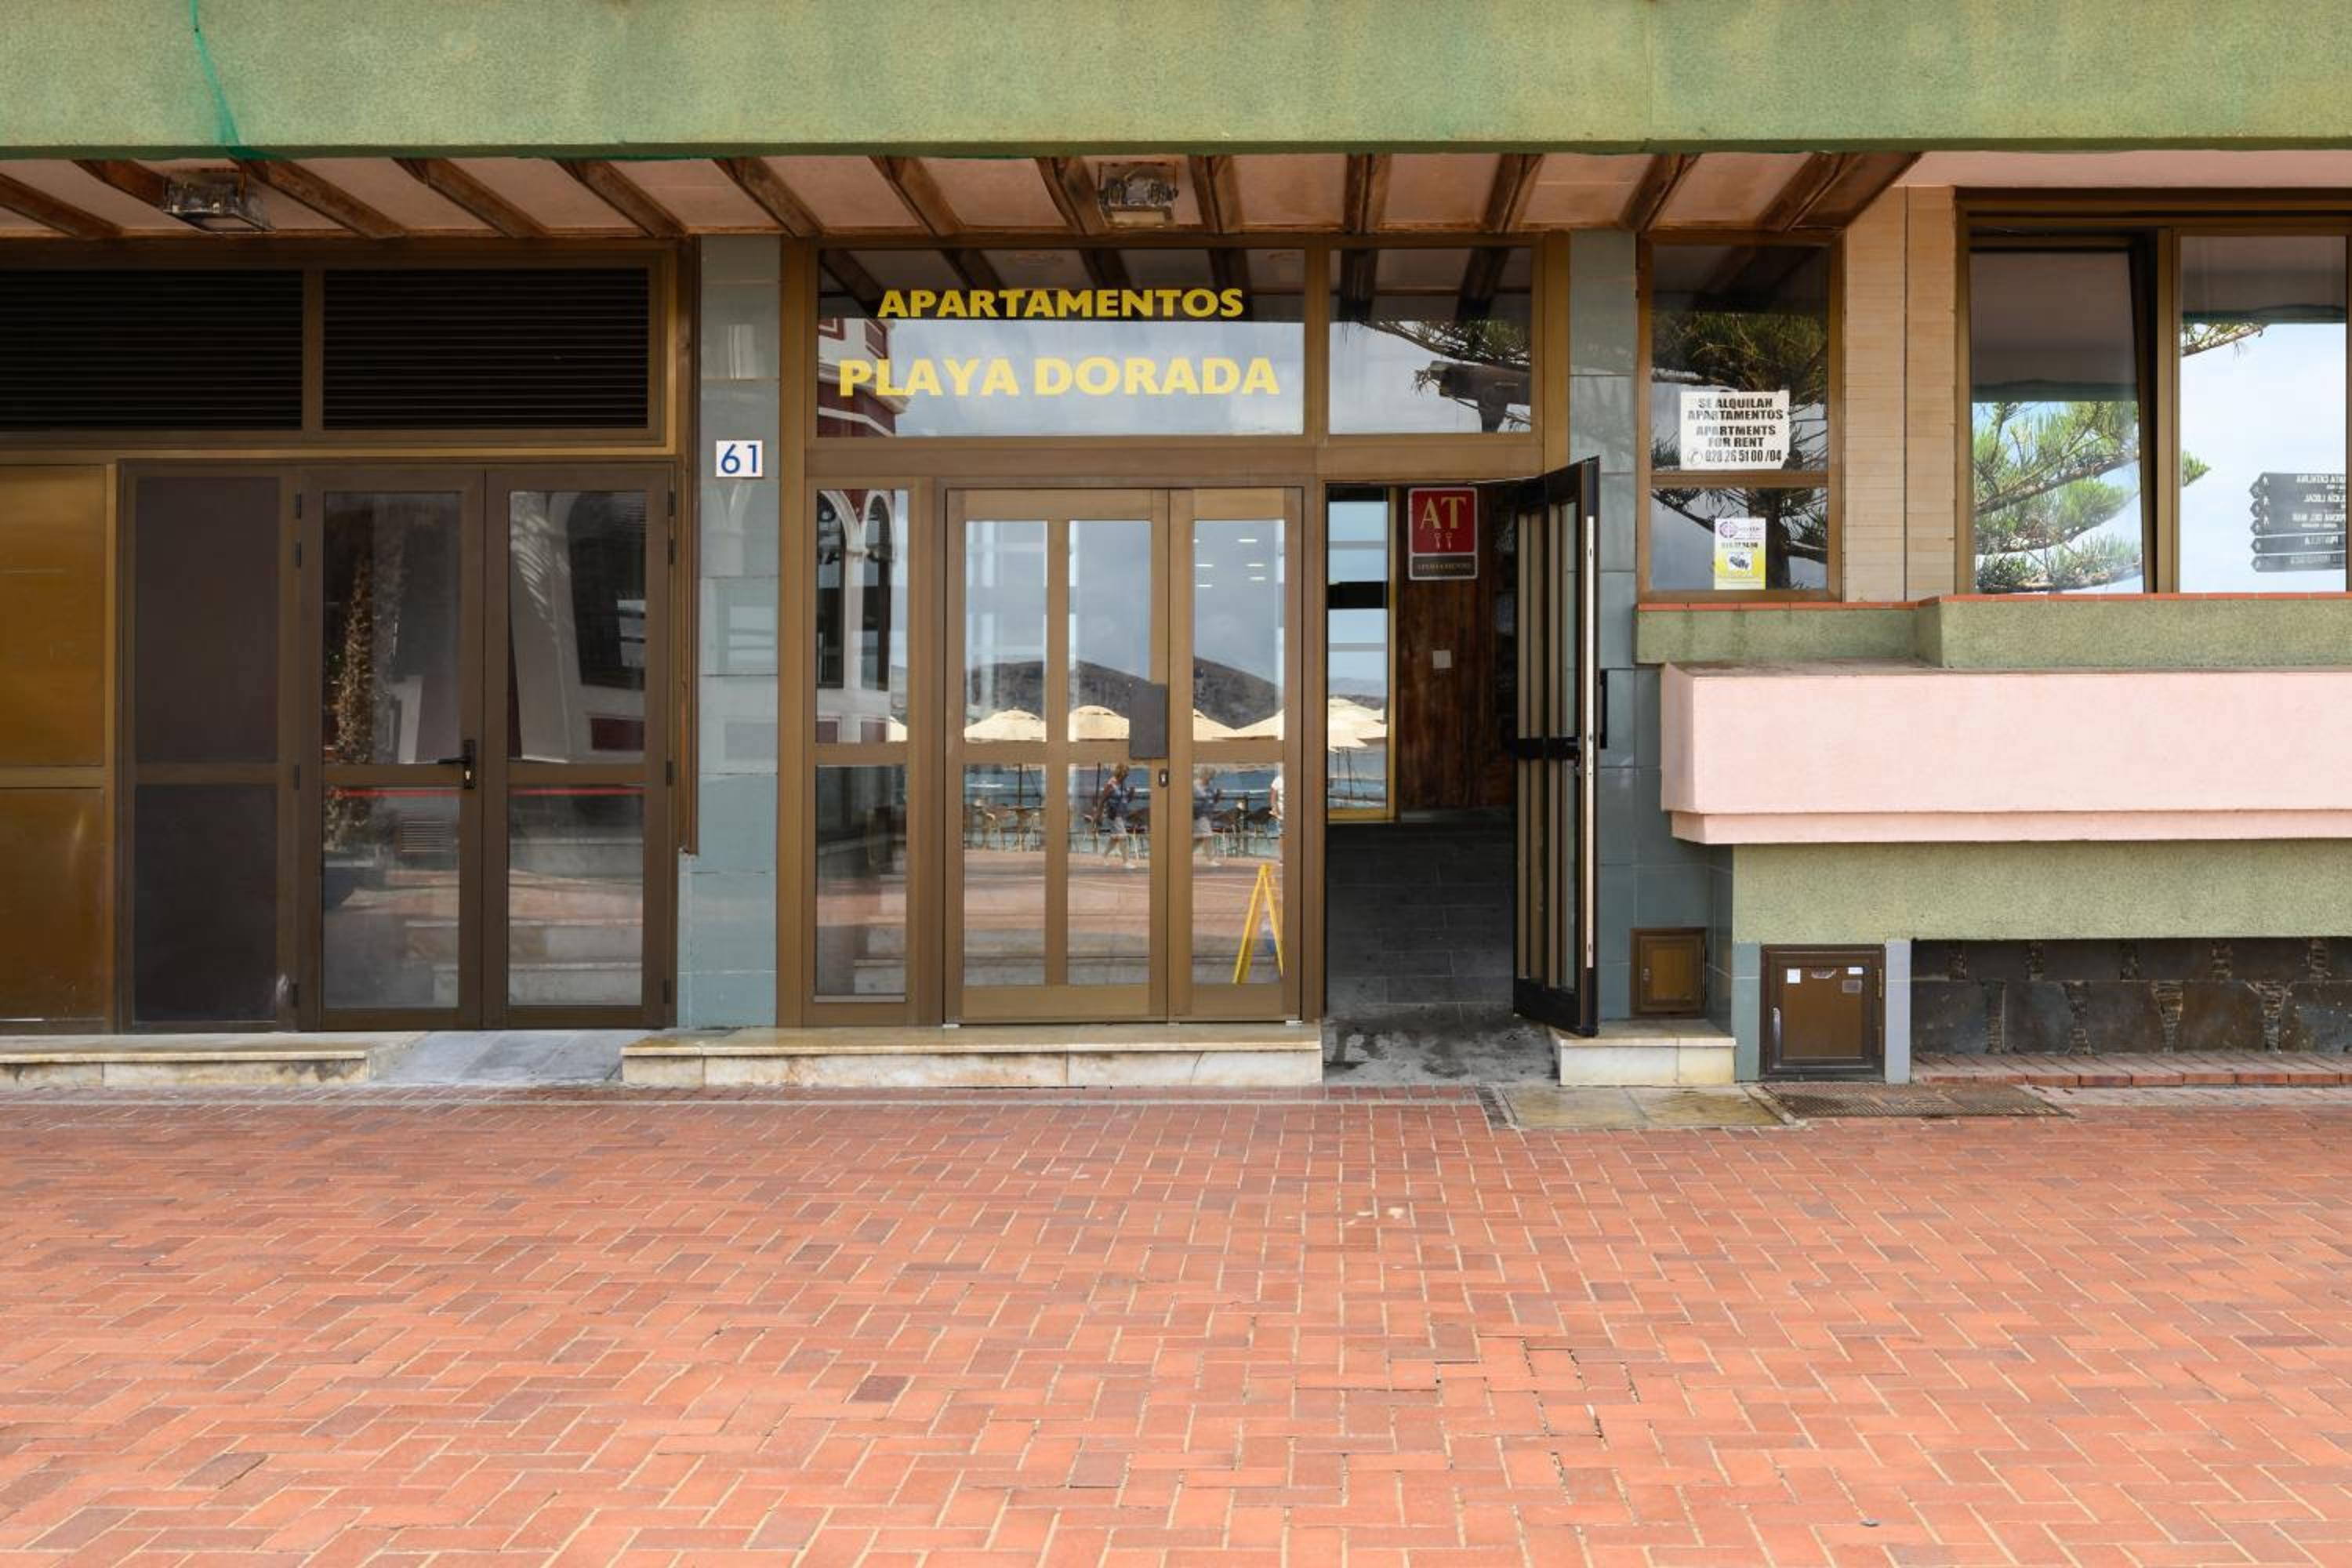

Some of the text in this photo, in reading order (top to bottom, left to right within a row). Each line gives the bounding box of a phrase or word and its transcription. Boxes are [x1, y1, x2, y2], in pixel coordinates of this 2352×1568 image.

[877, 288, 1244, 318] APARTAMENTOS
[840, 356, 1281, 397] PLAYA DORADA
[1697, 397, 1773, 409] SE ALQUILAN
[1687, 409, 1784, 420] APARTAMENTOS
[1696, 425, 1776, 436] APARTMENTS
[1708, 437, 1765, 448] FOR RENT
[720, 444, 757, 474] 61
[1419, 495, 1468, 530] AT
